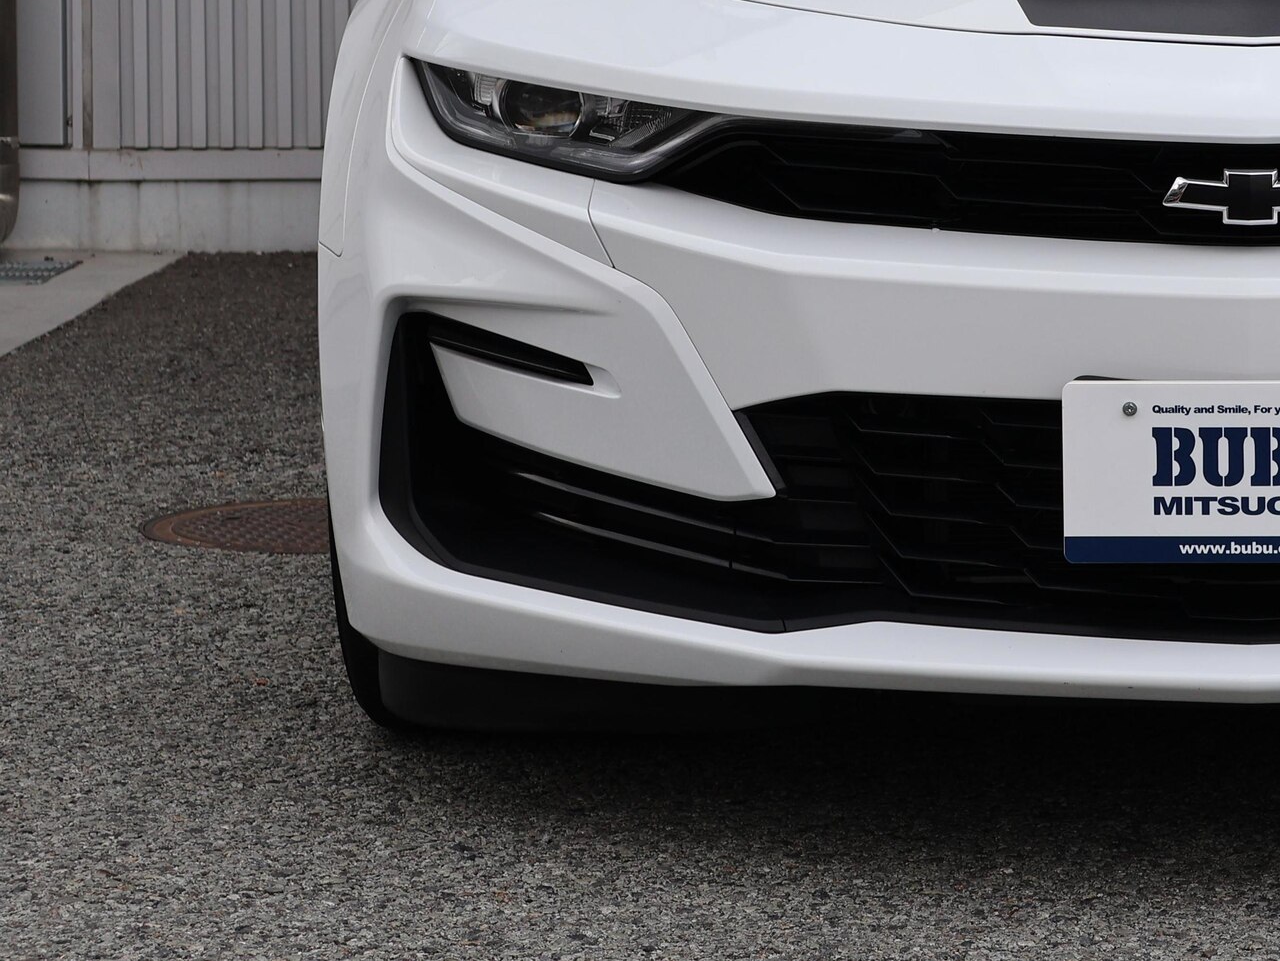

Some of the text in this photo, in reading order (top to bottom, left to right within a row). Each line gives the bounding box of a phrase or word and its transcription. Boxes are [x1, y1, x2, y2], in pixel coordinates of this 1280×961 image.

[1152, 404, 1191, 416] Quality
[1194, 404, 1214, 414] and
[1217, 404, 1251, 416] Smile,
[1254, 404, 1273, 414] For
